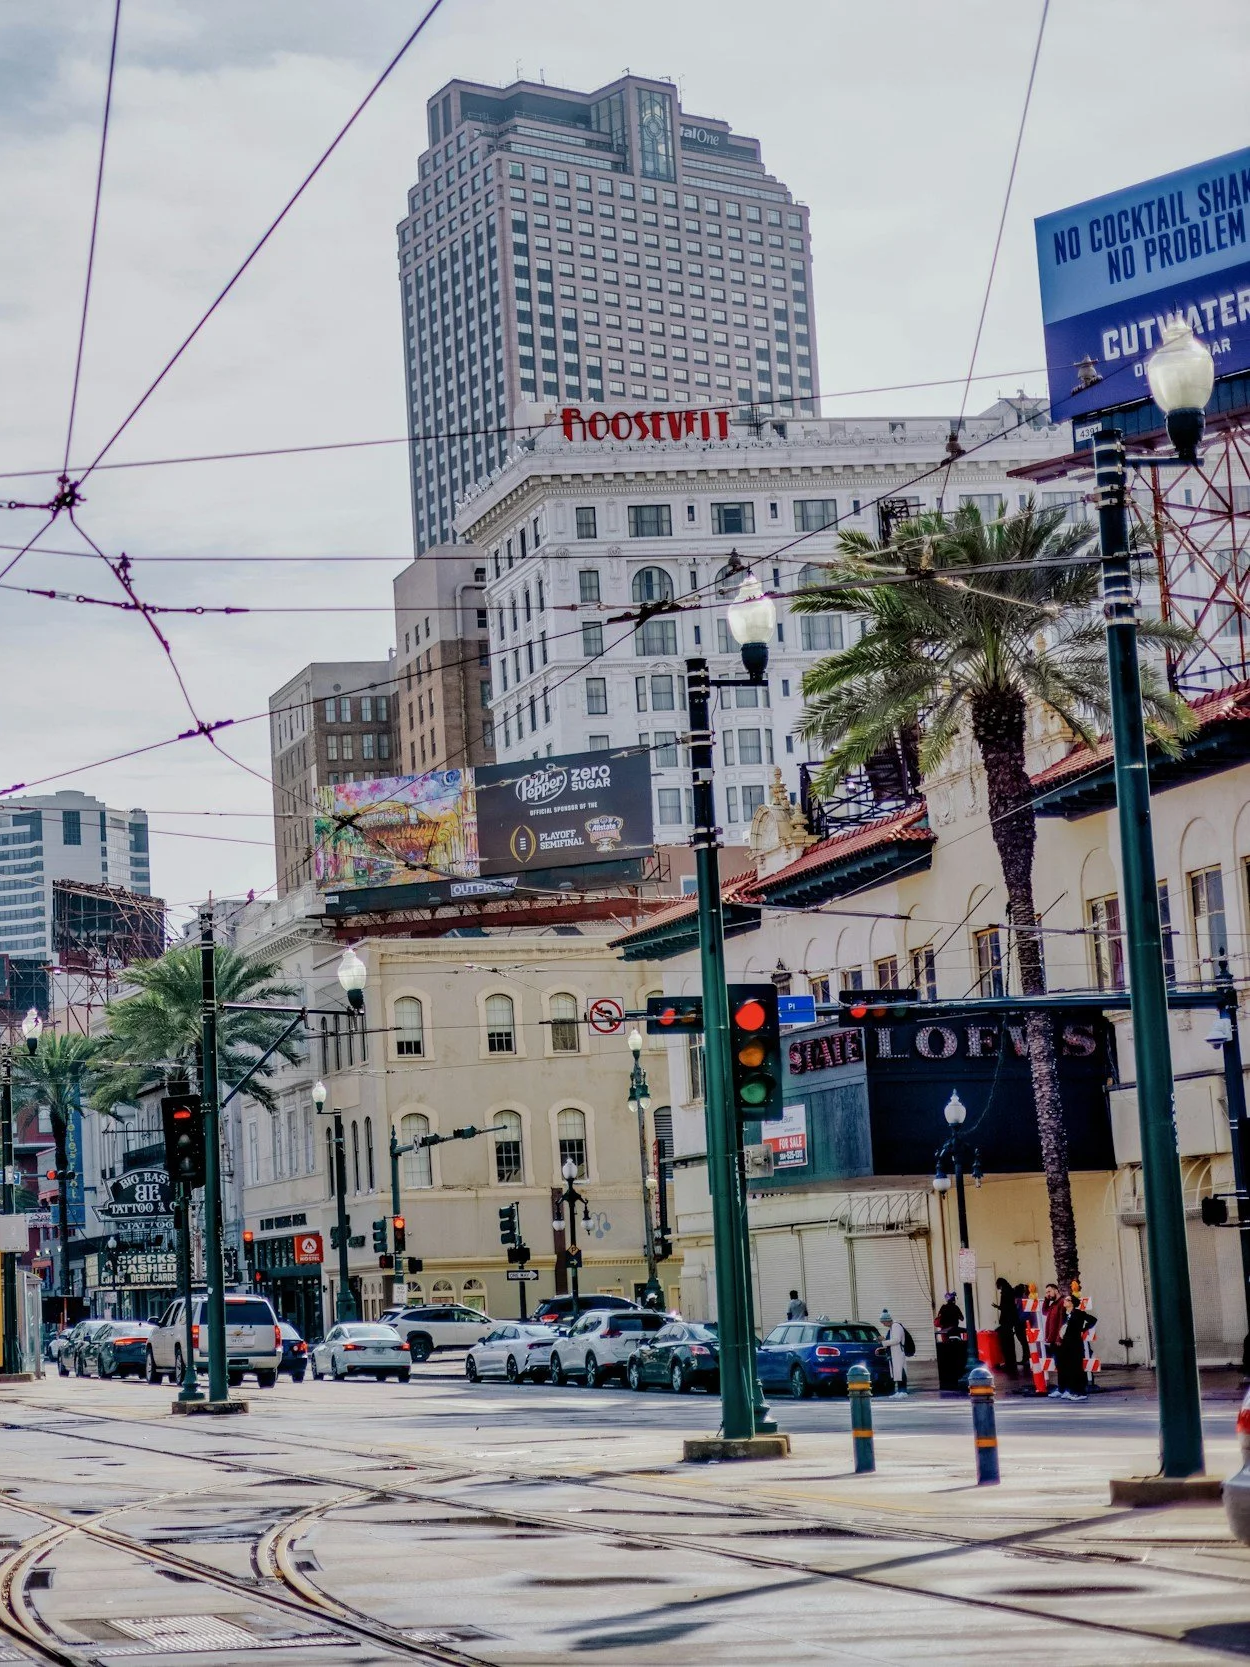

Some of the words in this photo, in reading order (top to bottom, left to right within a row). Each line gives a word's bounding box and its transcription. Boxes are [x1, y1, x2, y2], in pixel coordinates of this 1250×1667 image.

[680, 126, 719, 145] talOne
[1053, 226, 1081, 266] NO
[1089, 191, 1190, 253] COCKTAIL
[1107, 244, 1136, 285] NO
[1144, 208, 1247, 273] PROBLEM
[571, 765, 610, 781] zero
[520, 775, 564, 802] Pepper
[571, 777, 611, 791] SUGAR
[530, 808, 552, 816] OFFICIAL
[554, 804, 578, 813] SPONSOR
[588, 801, 598, 809] THE
[539, 829, 576, 842] PLAYOFF
[539, 837, 584, 850] SEMIFINAL
[789, 1029, 863, 1075] STATE
[779, 1138, 788, 1150] FOR
[790, 1136, 802, 1148] SALE
[119, 1174, 140, 1190] BIG
[109, 1202, 154, 1215] TATTOO
[117, 1254, 177, 1265] CHECKS
[117, 1263, 177, 1274] CASHED
[131, 1273, 151, 1283] DEBIT
[153, 1272, 177, 1282] CARDS
